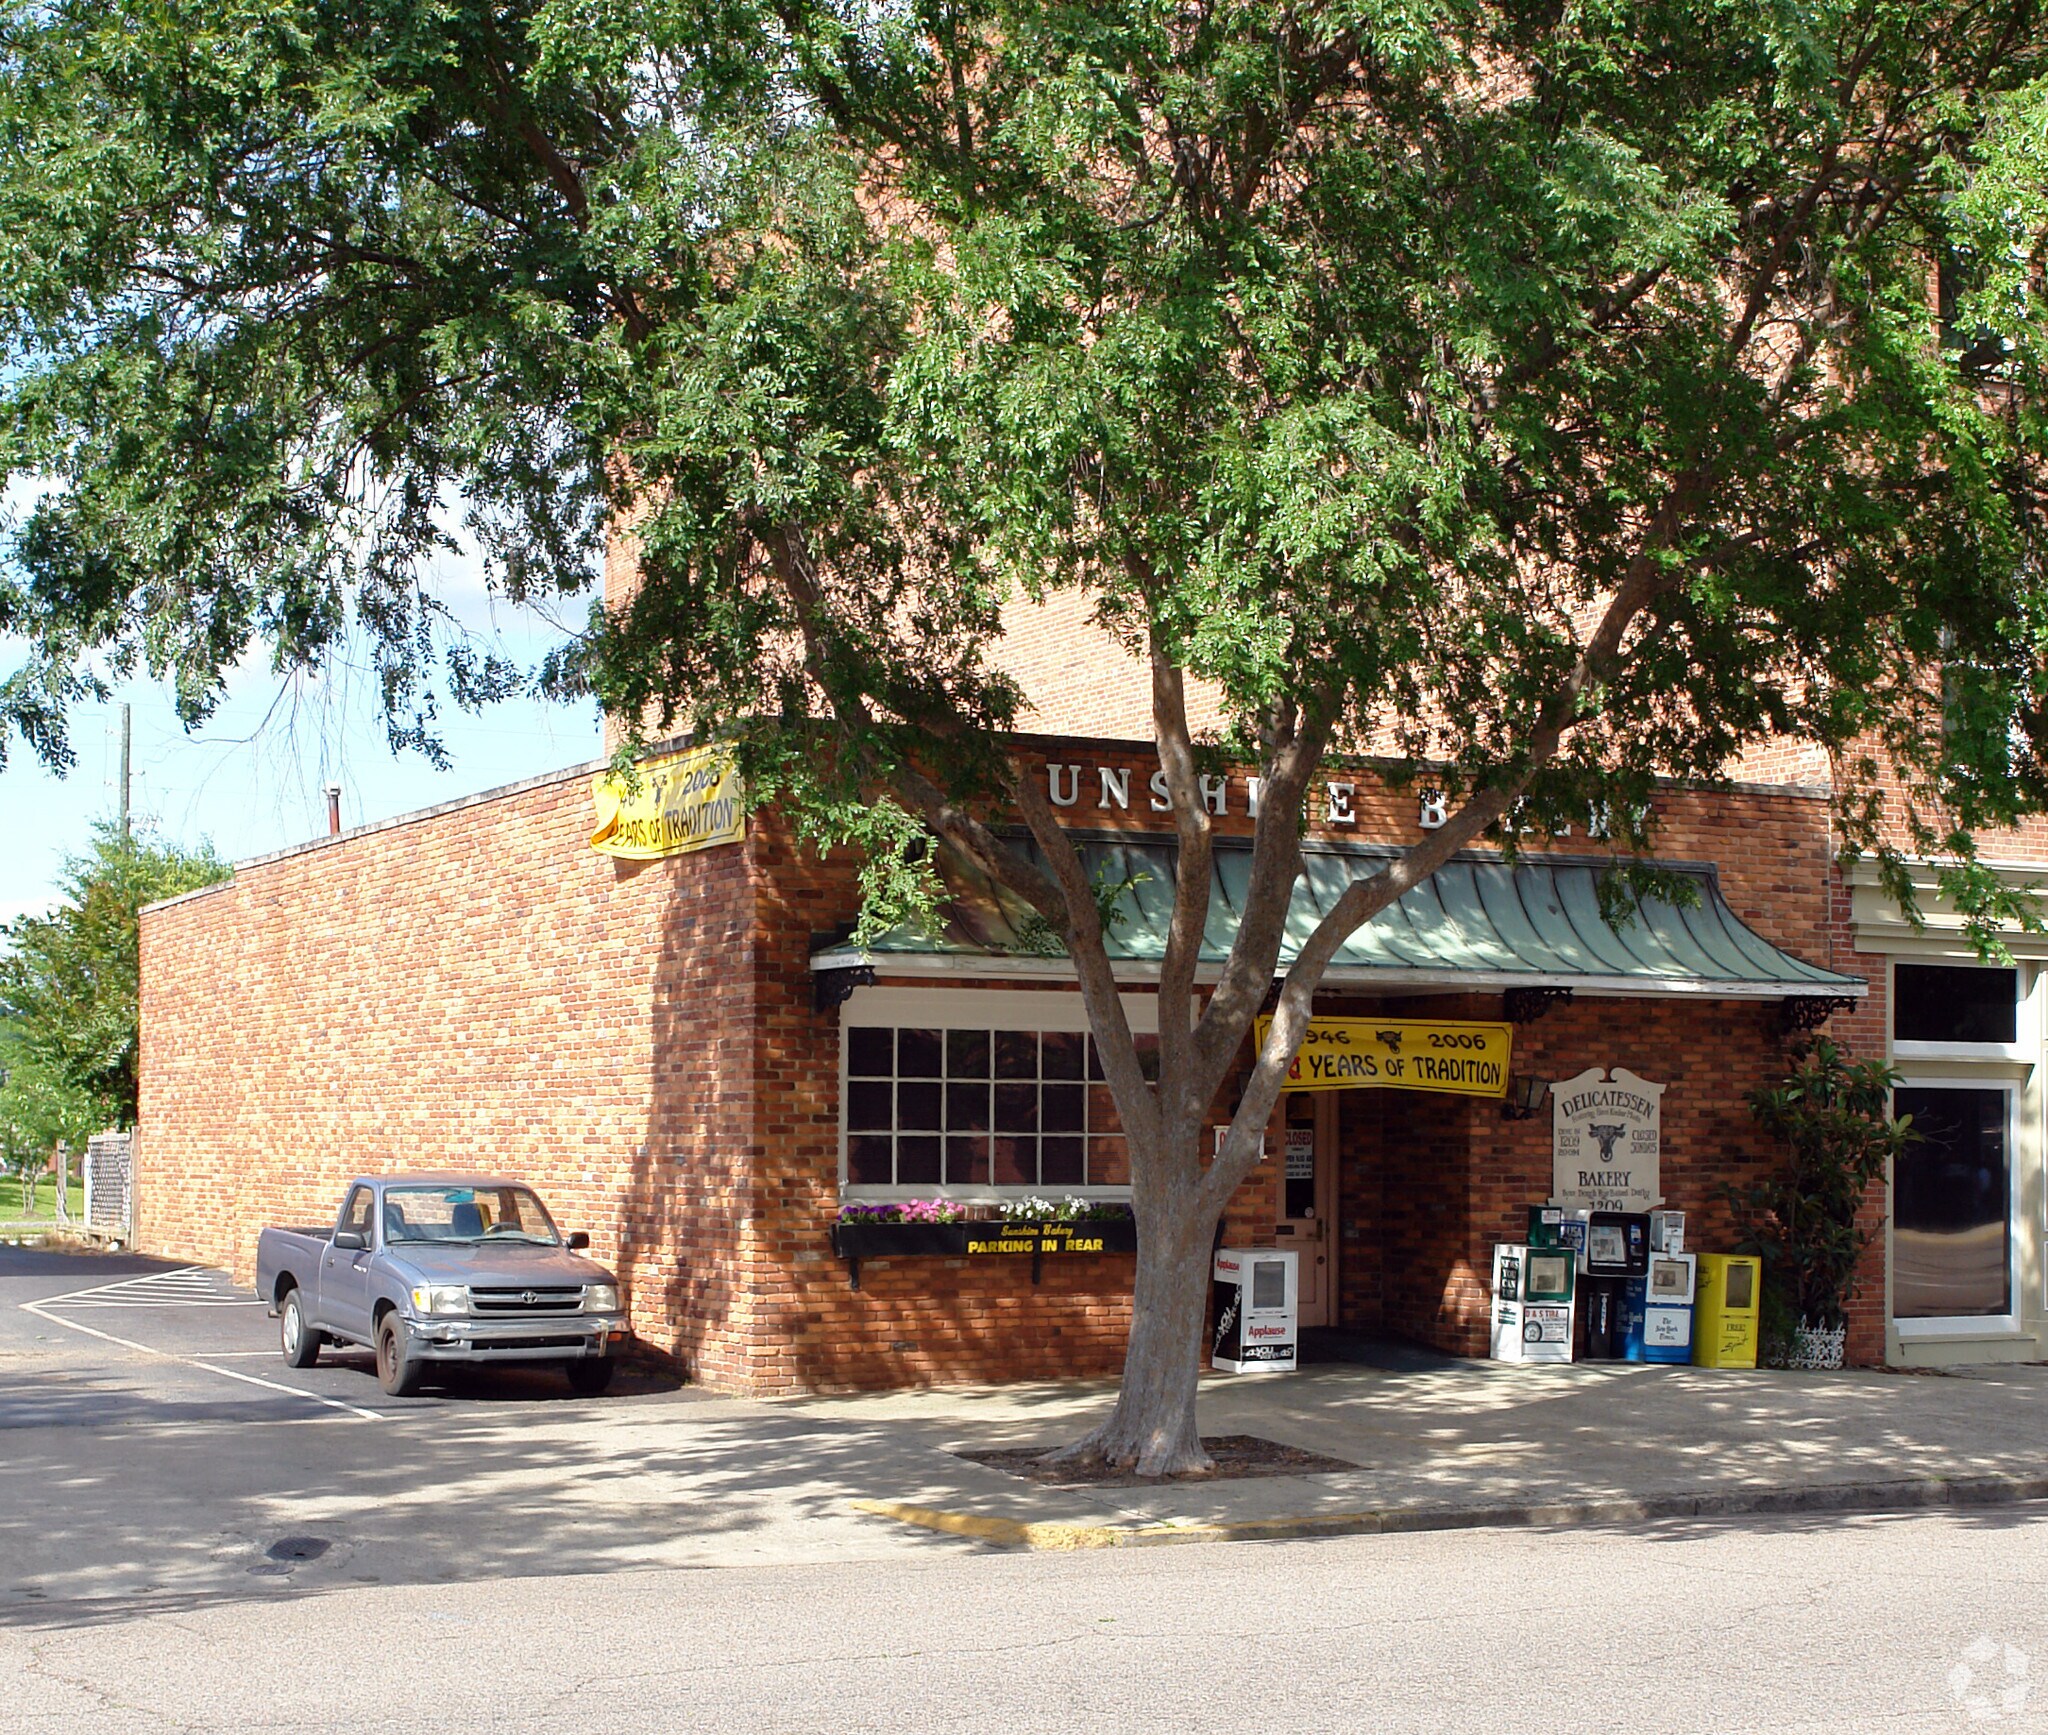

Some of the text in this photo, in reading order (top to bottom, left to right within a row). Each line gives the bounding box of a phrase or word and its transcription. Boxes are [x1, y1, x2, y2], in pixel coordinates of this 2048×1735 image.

[608, 797, 733, 848] EARS OF TRADITION
[1301, 1029, 1487, 1050] 946 2006
[1308, 1055, 1378, 1078] YEARS
[1385, 1059, 1405, 1077] OF
[1412, 1056, 1501, 1086] TRADITION
[1561, 1090, 1655, 1120] DELICATESSEN
[1631, 1129, 1658, 1142] CLOSED
[1578, 1171, 1632, 1187] BAKERY
[1043, 1224, 1073, 1238] Bakery
[967, 1238, 1104, 1254] PARKING IN REAR
[1216, 1257, 1240, 1273] Applause
[1502, 1279, 1516, 1289] CAN
[1248, 1324, 1287, 1339] Applause
